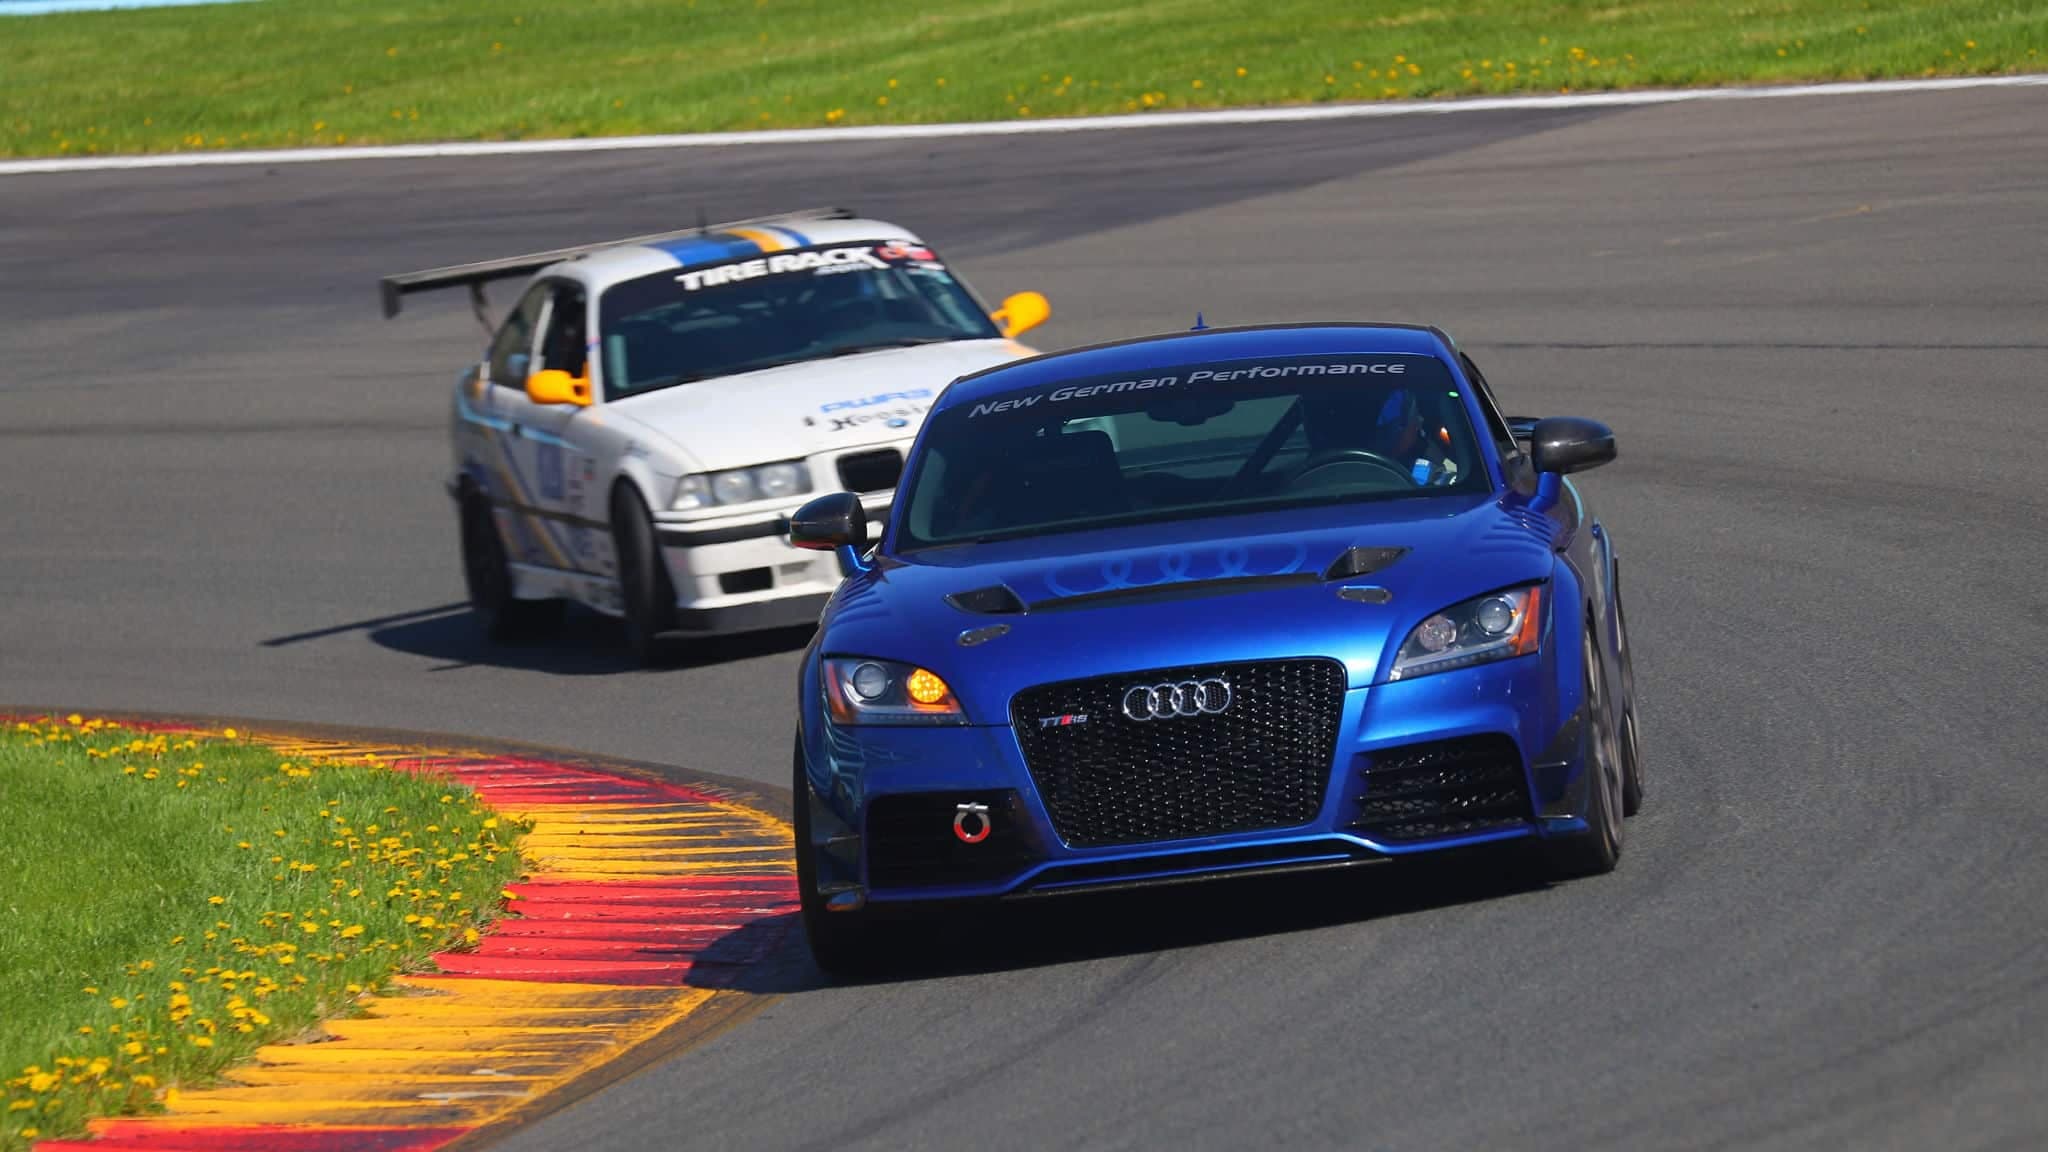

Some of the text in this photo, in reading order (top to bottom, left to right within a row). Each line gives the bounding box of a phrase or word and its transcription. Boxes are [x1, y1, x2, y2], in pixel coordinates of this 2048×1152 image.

[674, 258, 769, 291] TIRE
[768, 246, 891, 274] RACK
[1049, 375, 1178, 402] German
[1186, 363, 1406, 385] Performance
